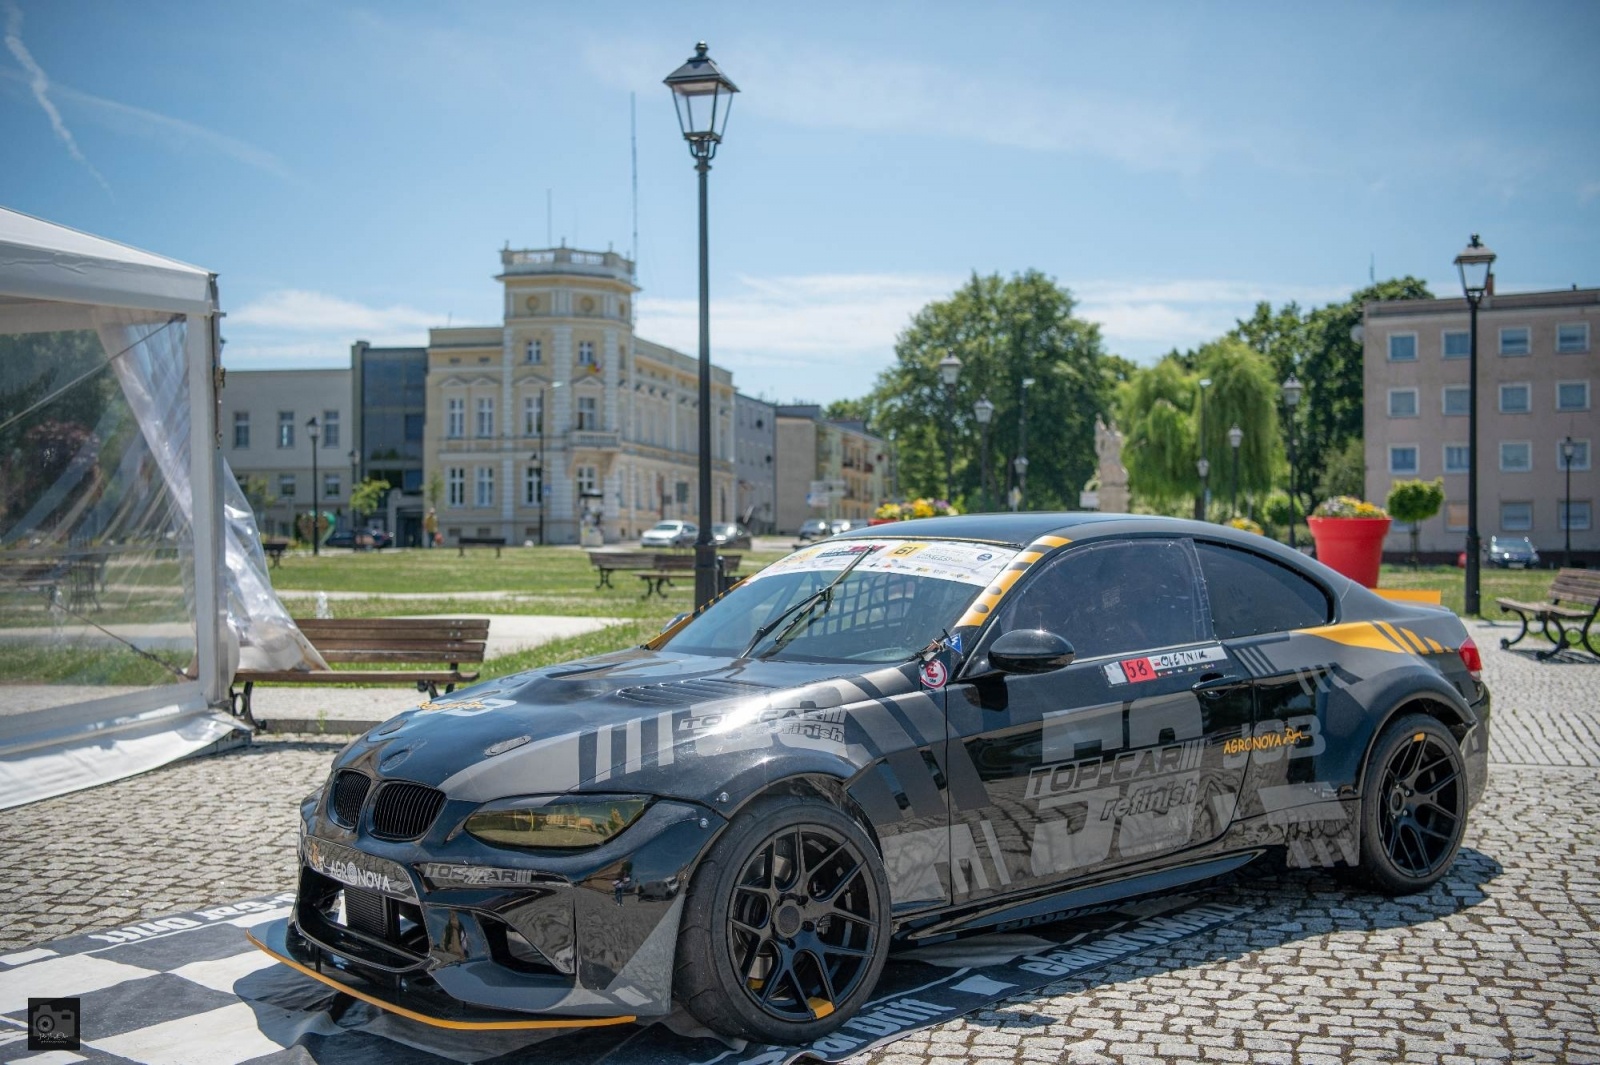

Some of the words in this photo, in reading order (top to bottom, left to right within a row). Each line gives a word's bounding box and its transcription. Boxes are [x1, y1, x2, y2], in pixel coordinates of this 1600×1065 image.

[1125, 661, 1148, 678] 58
[1223, 733, 1282, 755] AGRONOVA
[1100, 778, 1198, 821] refinish
[842, 997, 957, 1037] Drift
